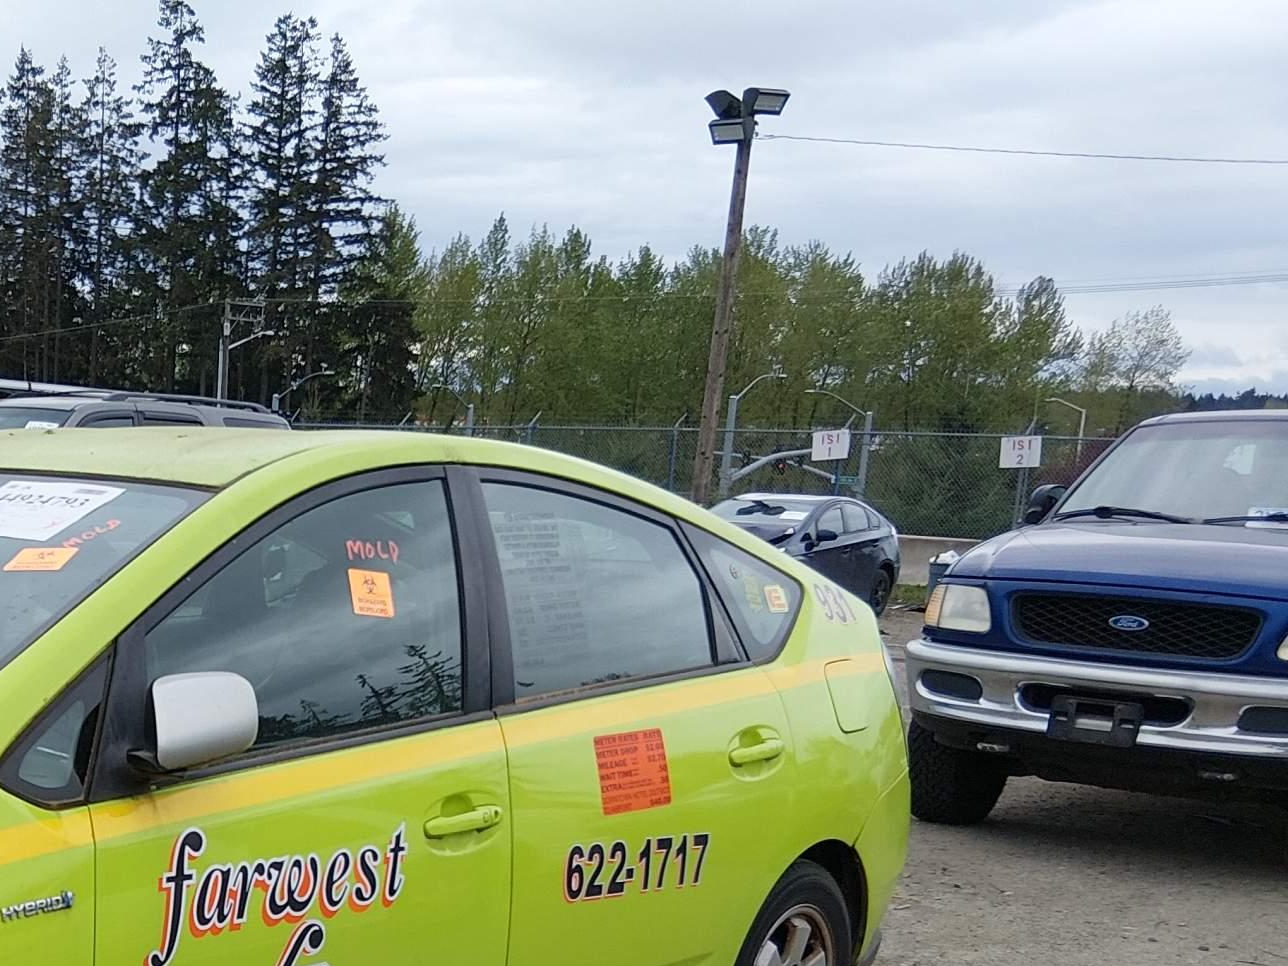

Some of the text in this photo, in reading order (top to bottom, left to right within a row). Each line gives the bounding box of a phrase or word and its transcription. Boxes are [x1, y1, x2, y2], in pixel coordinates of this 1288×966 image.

[1016, 454, 1024, 465] 2
[62, 518, 121, 549] MOLD
[346, 540, 399, 565] MOLD
[813, 583, 859, 625] 931
[564, 833, 710, 903] 622-1717
[0, 896, 64, 922] HYBRID
